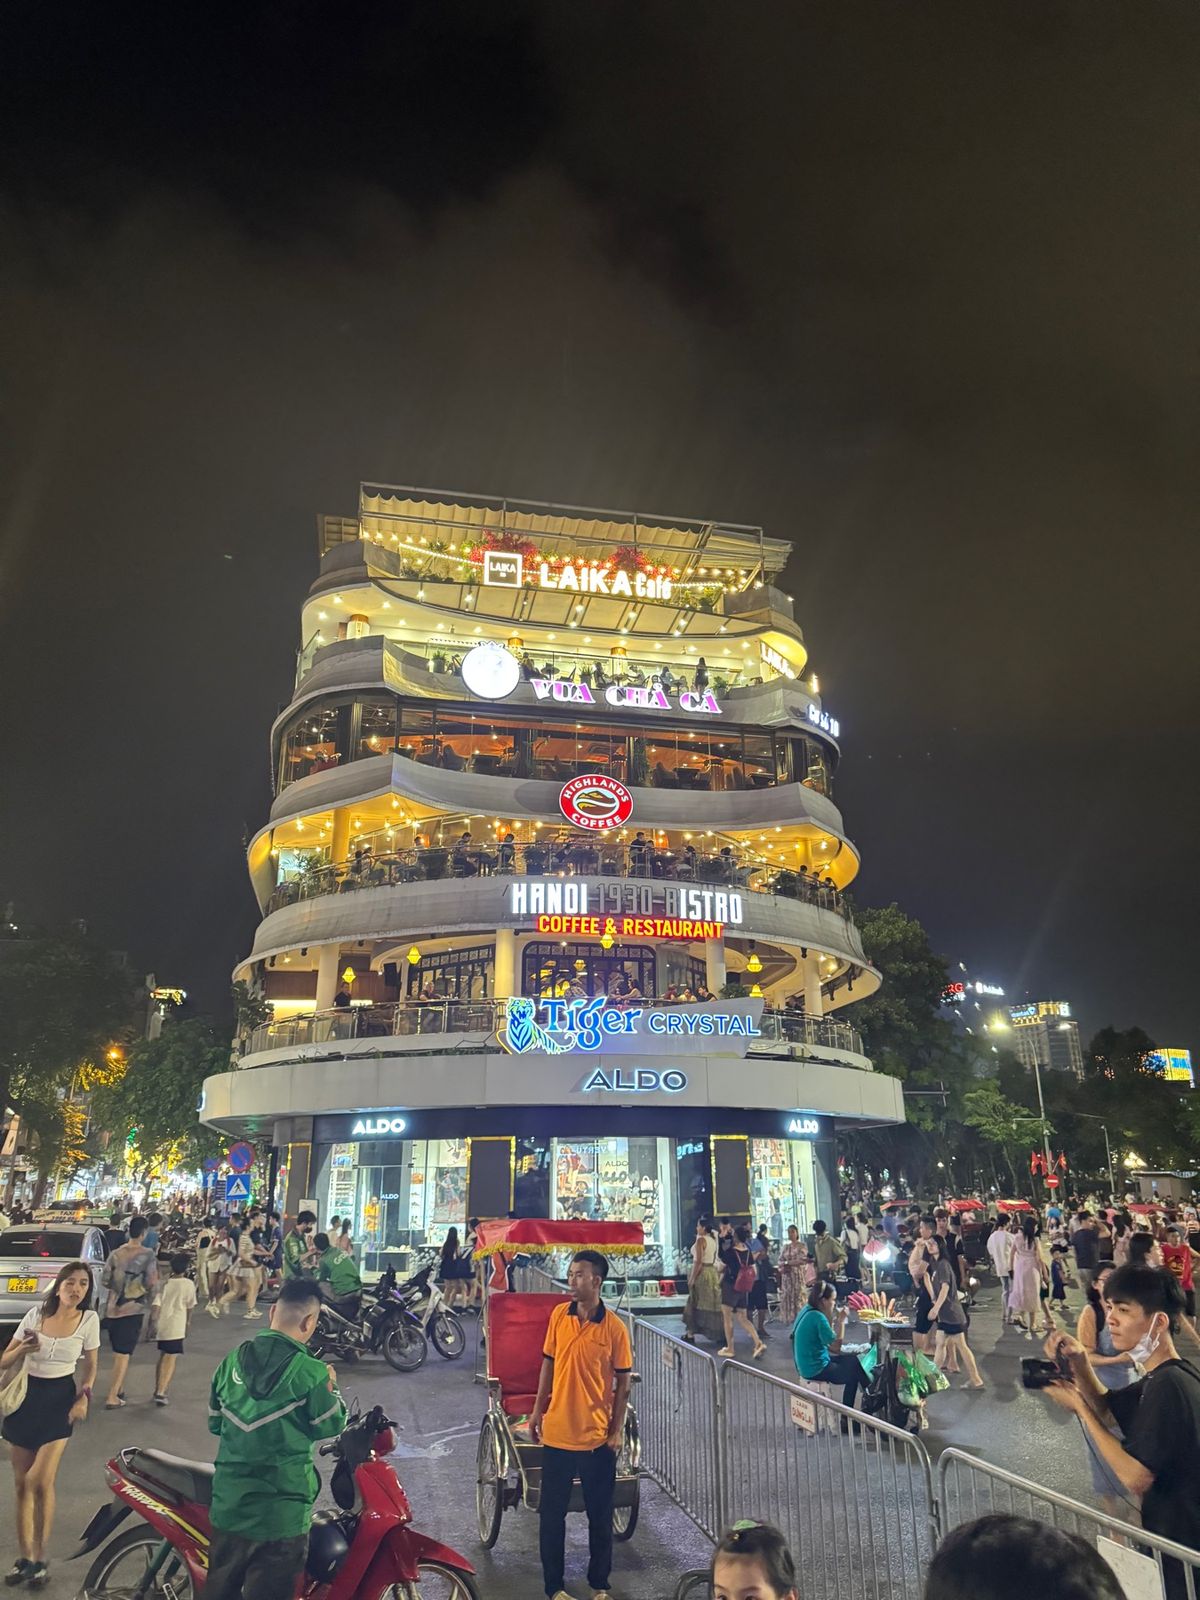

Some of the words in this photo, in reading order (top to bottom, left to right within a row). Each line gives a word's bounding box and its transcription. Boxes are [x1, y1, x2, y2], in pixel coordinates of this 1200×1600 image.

[490, 561, 516, 574] LAIKA
[540, 563, 633, 597] LAIKA
[530, 678, 596, 704] VUA
[605, 682, 672, 710] CHẢ
[680, 687, 723, 714] CÁ
[563, 778, 630, 803] HIGHLANDS
[571, 813, 622, 828] COFFEE
[512, 883, 588, 914] HANOI
[598, 883, 653, 915] 1930
[666, 887, 744, 924] BISTRO
[538, 915, 600, 934] COFFEE
[605, 917, 617, 934] &
[623, 918, 725, 938] RESTAURANT
[541, 996, 642, 1050] Tiger
[649, 1014, 761, 1036] CRYSTAL
[583, 1068, 688, 1092] ALDO
[351, 1118, 406, 1135] ALDO
[788, 1119, 819, 1134] ALDO
